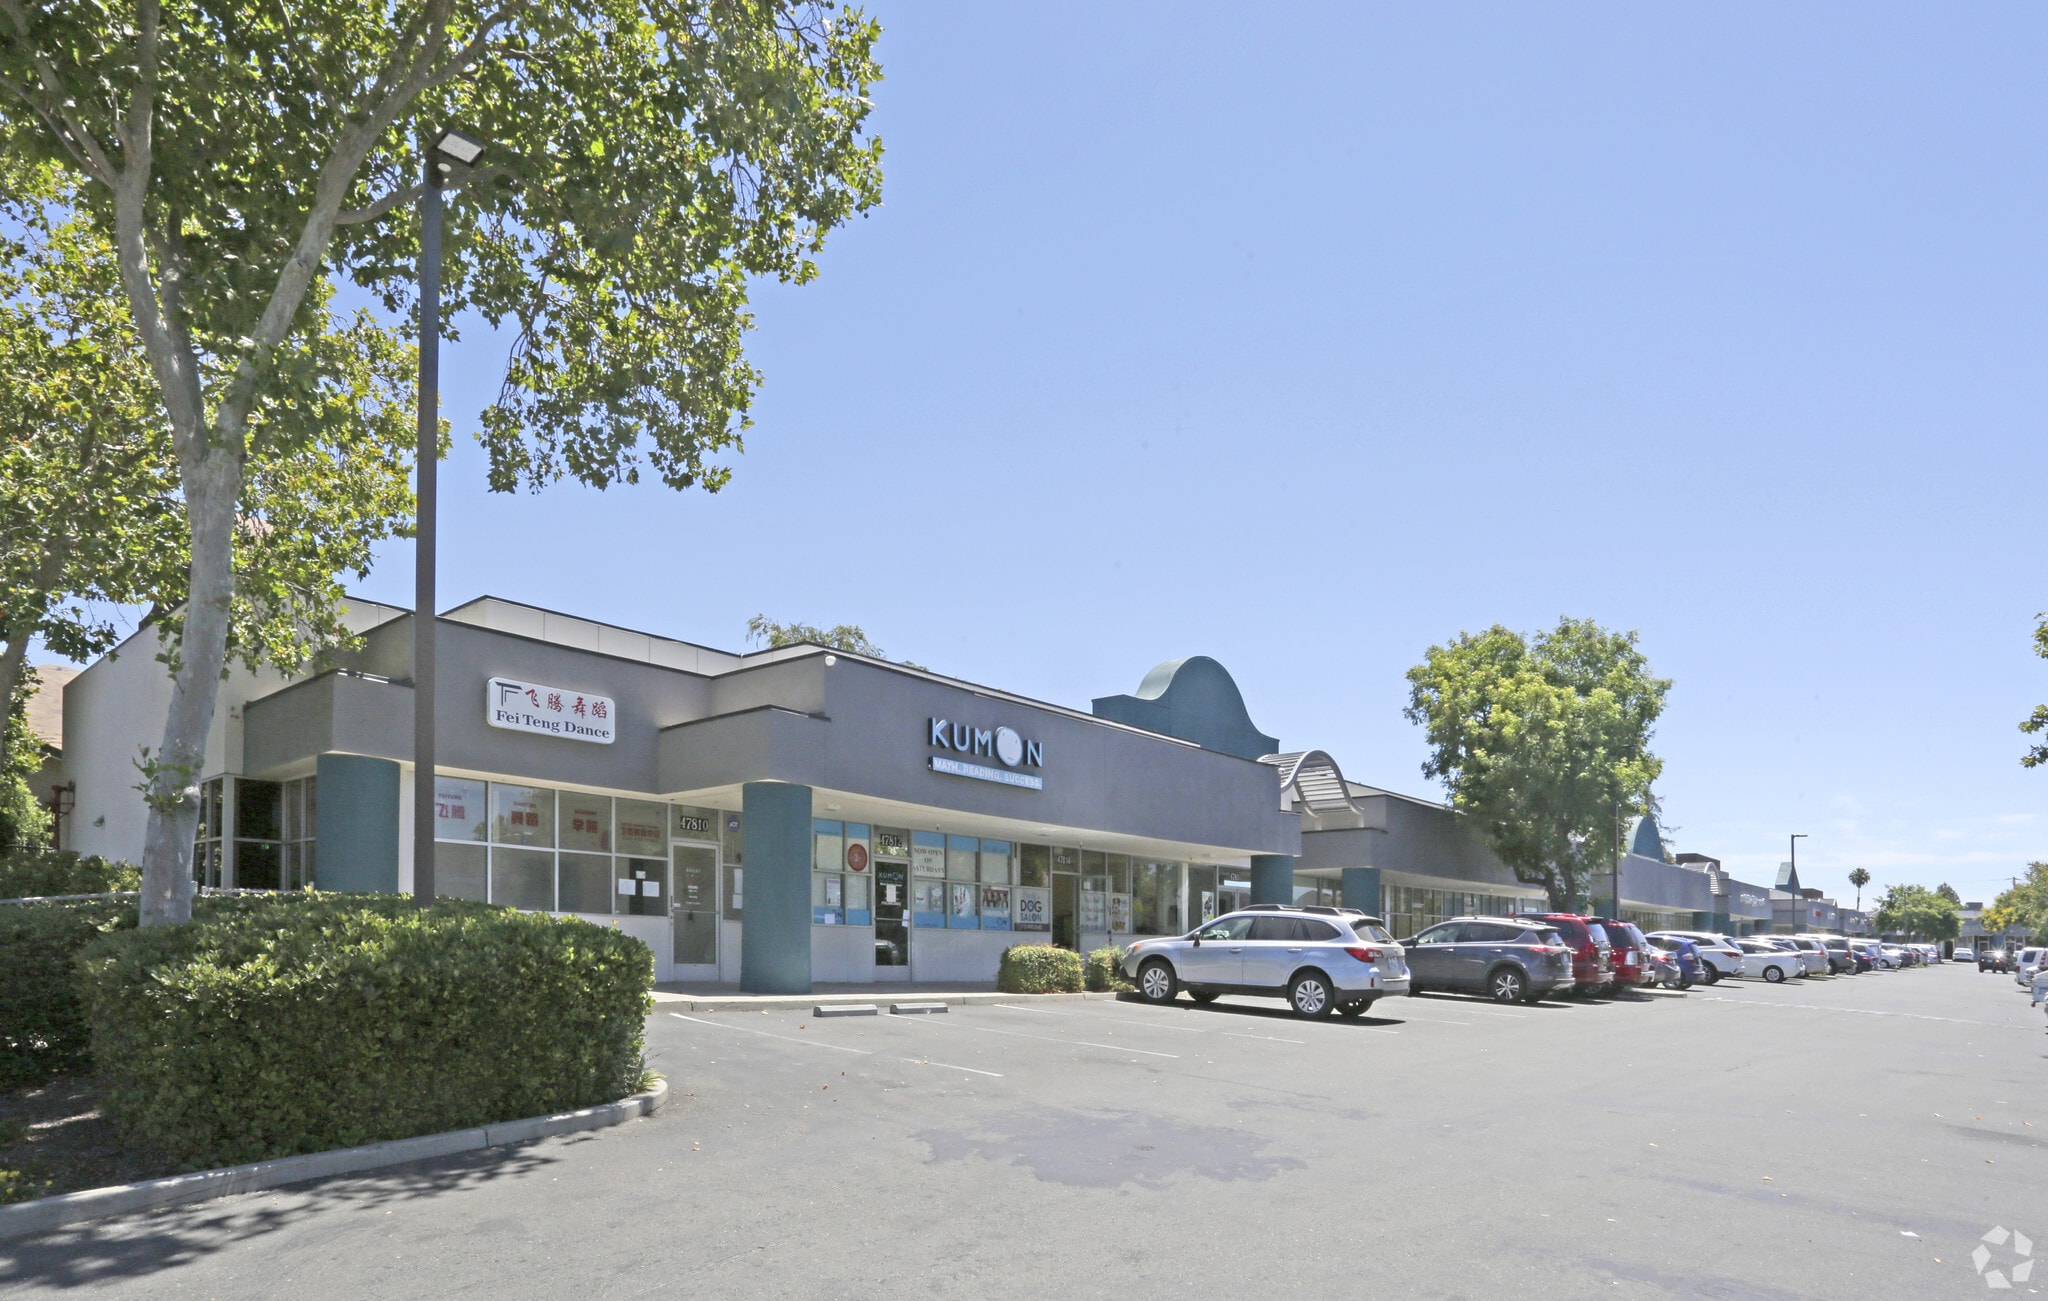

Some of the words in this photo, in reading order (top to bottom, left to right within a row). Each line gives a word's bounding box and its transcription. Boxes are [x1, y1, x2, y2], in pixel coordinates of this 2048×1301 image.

[525, 688, 608, 719] 飞腾舞蹈
[495, 710, 519, 724] Fei
[522, 714, 561, 733] Teng
[564, 721, 610, 739] Dance
[929, 717, 1042, 767] KUMON
[962, 763, 1002, 780] READING.
[680, 816, 709, 831] 47810
[881, 834, 902, 847] 47812
[914, 847, 927, 855] NOW
[928, 848, 943, 857] OPEN
[1020, 899, 1042, 913] DOG
[1020, 912, 1042, 922] SALON
